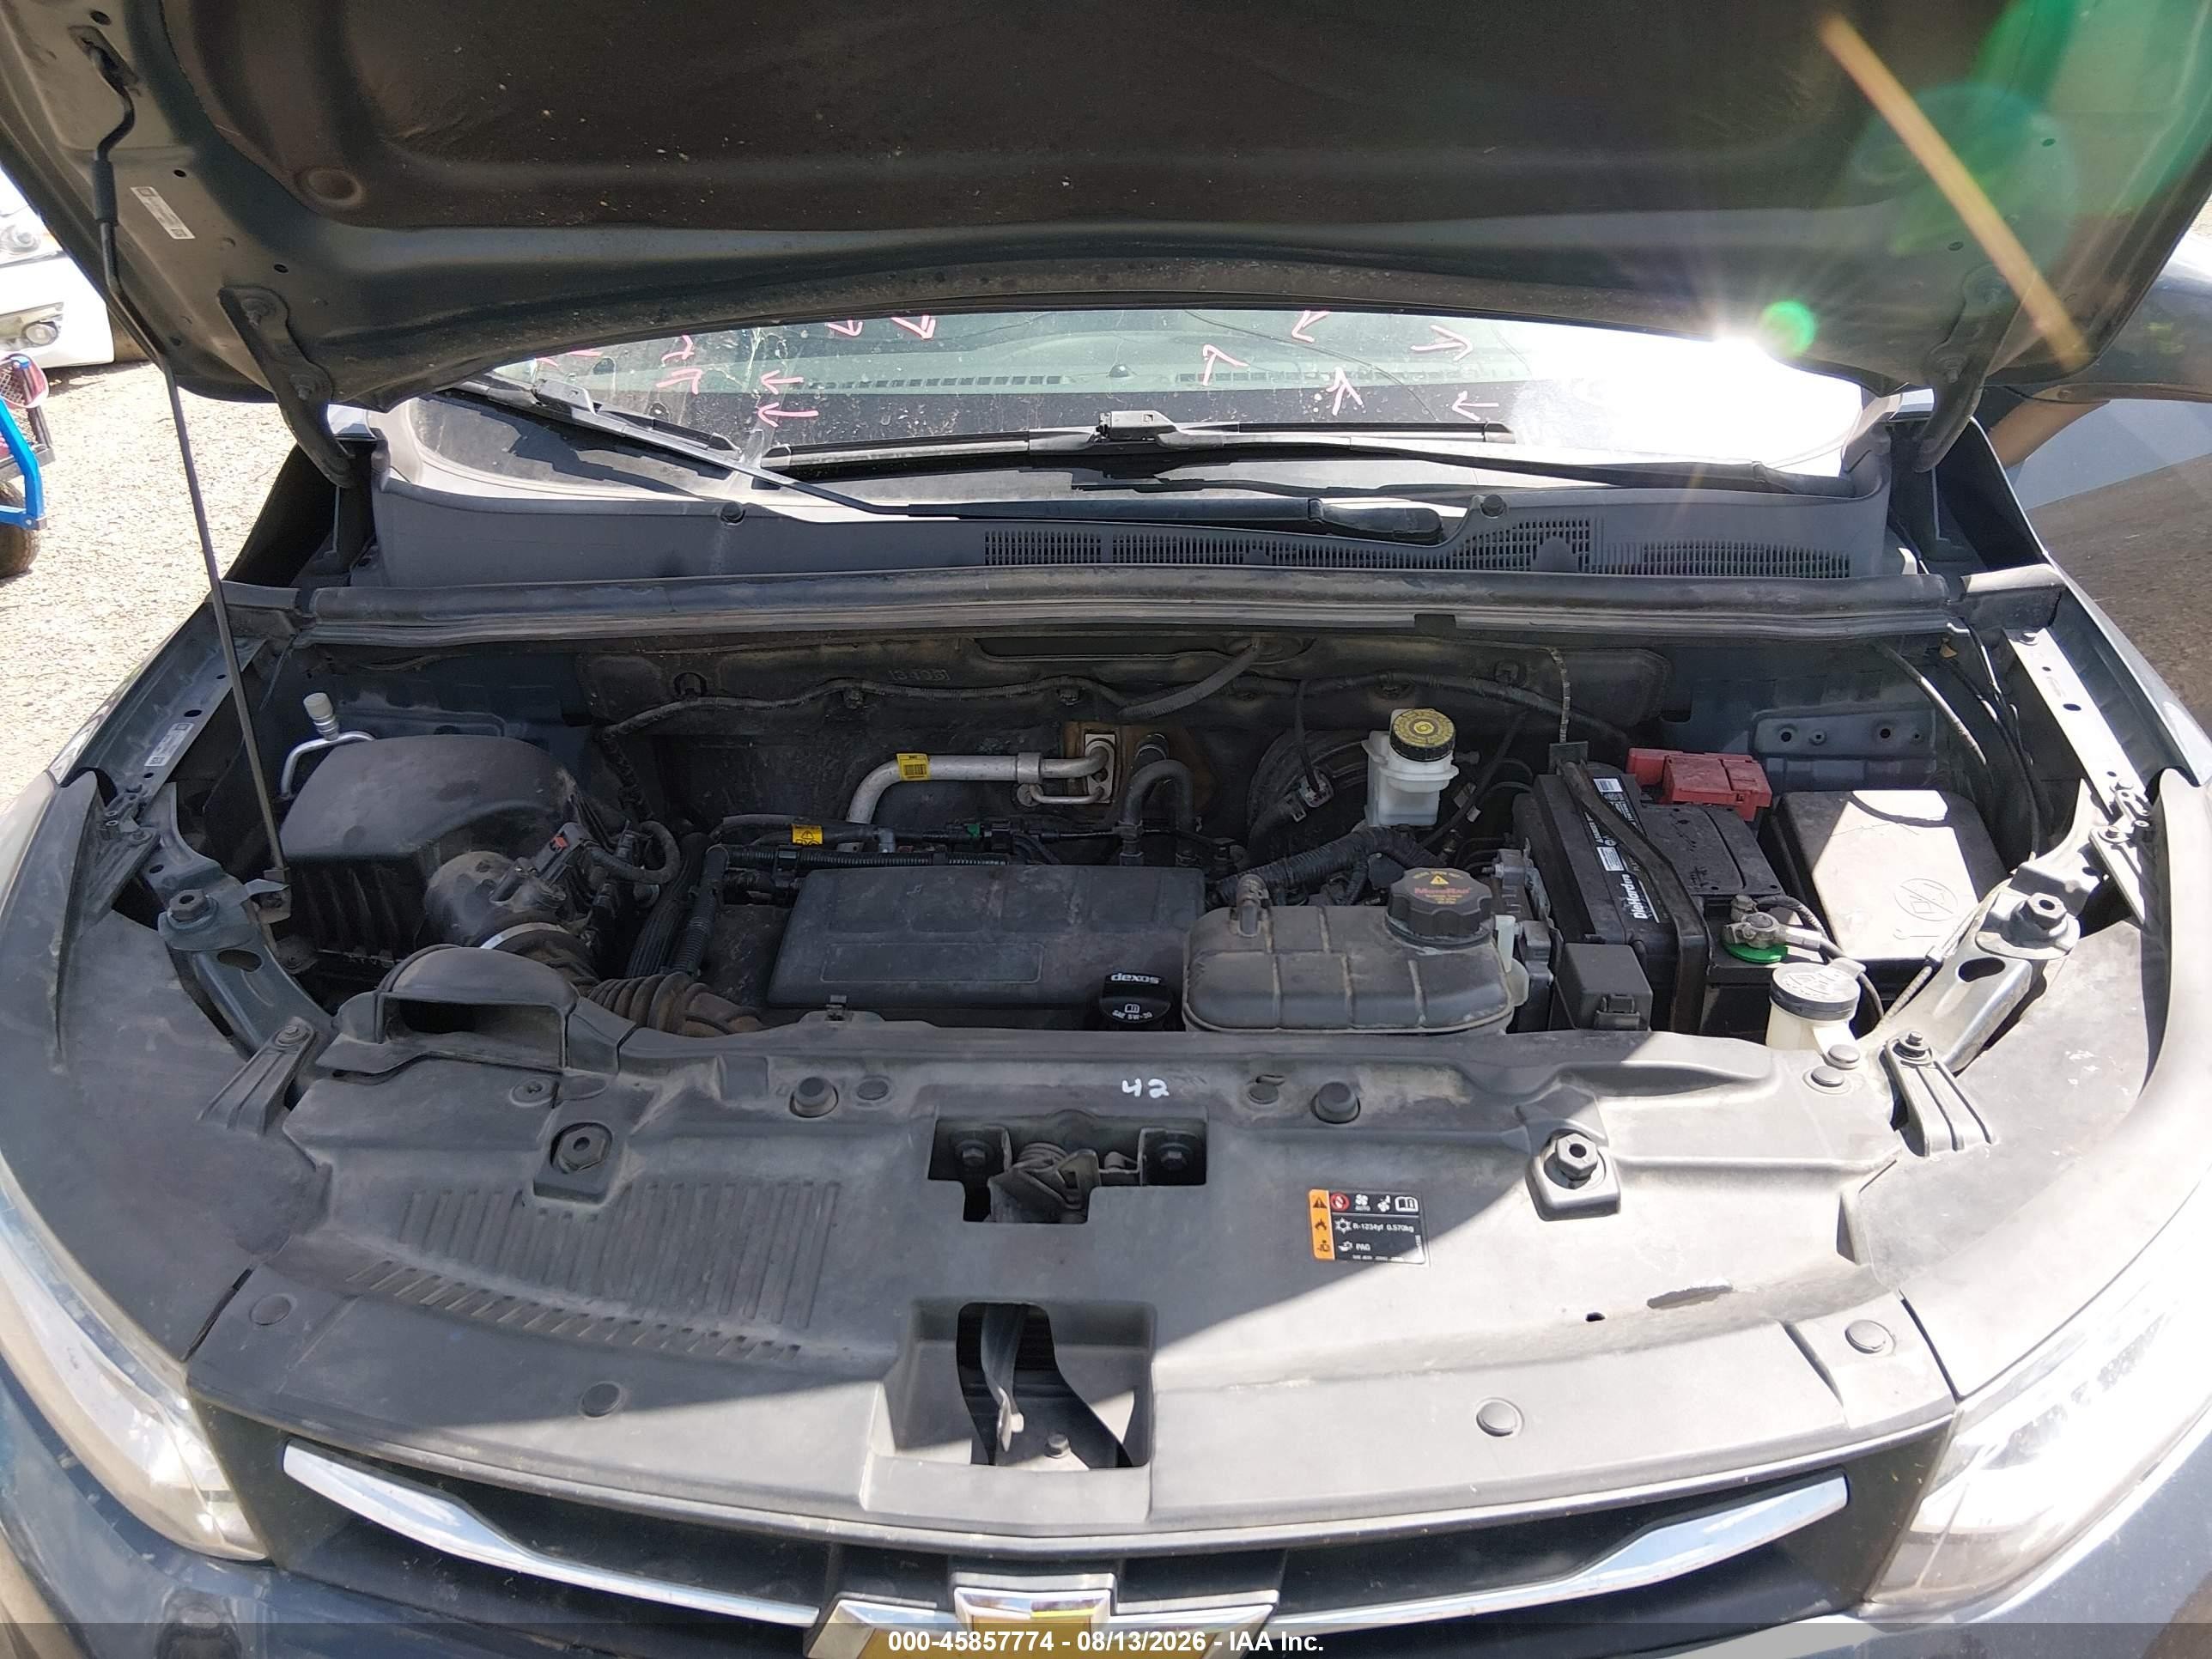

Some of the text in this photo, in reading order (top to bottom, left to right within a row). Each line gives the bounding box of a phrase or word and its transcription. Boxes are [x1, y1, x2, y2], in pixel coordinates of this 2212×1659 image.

[1620, 884, 1648, 919] DieHard
[1110, 973, 1161, 984] dexos
[1121, 1078, 1170, 1099] 42
